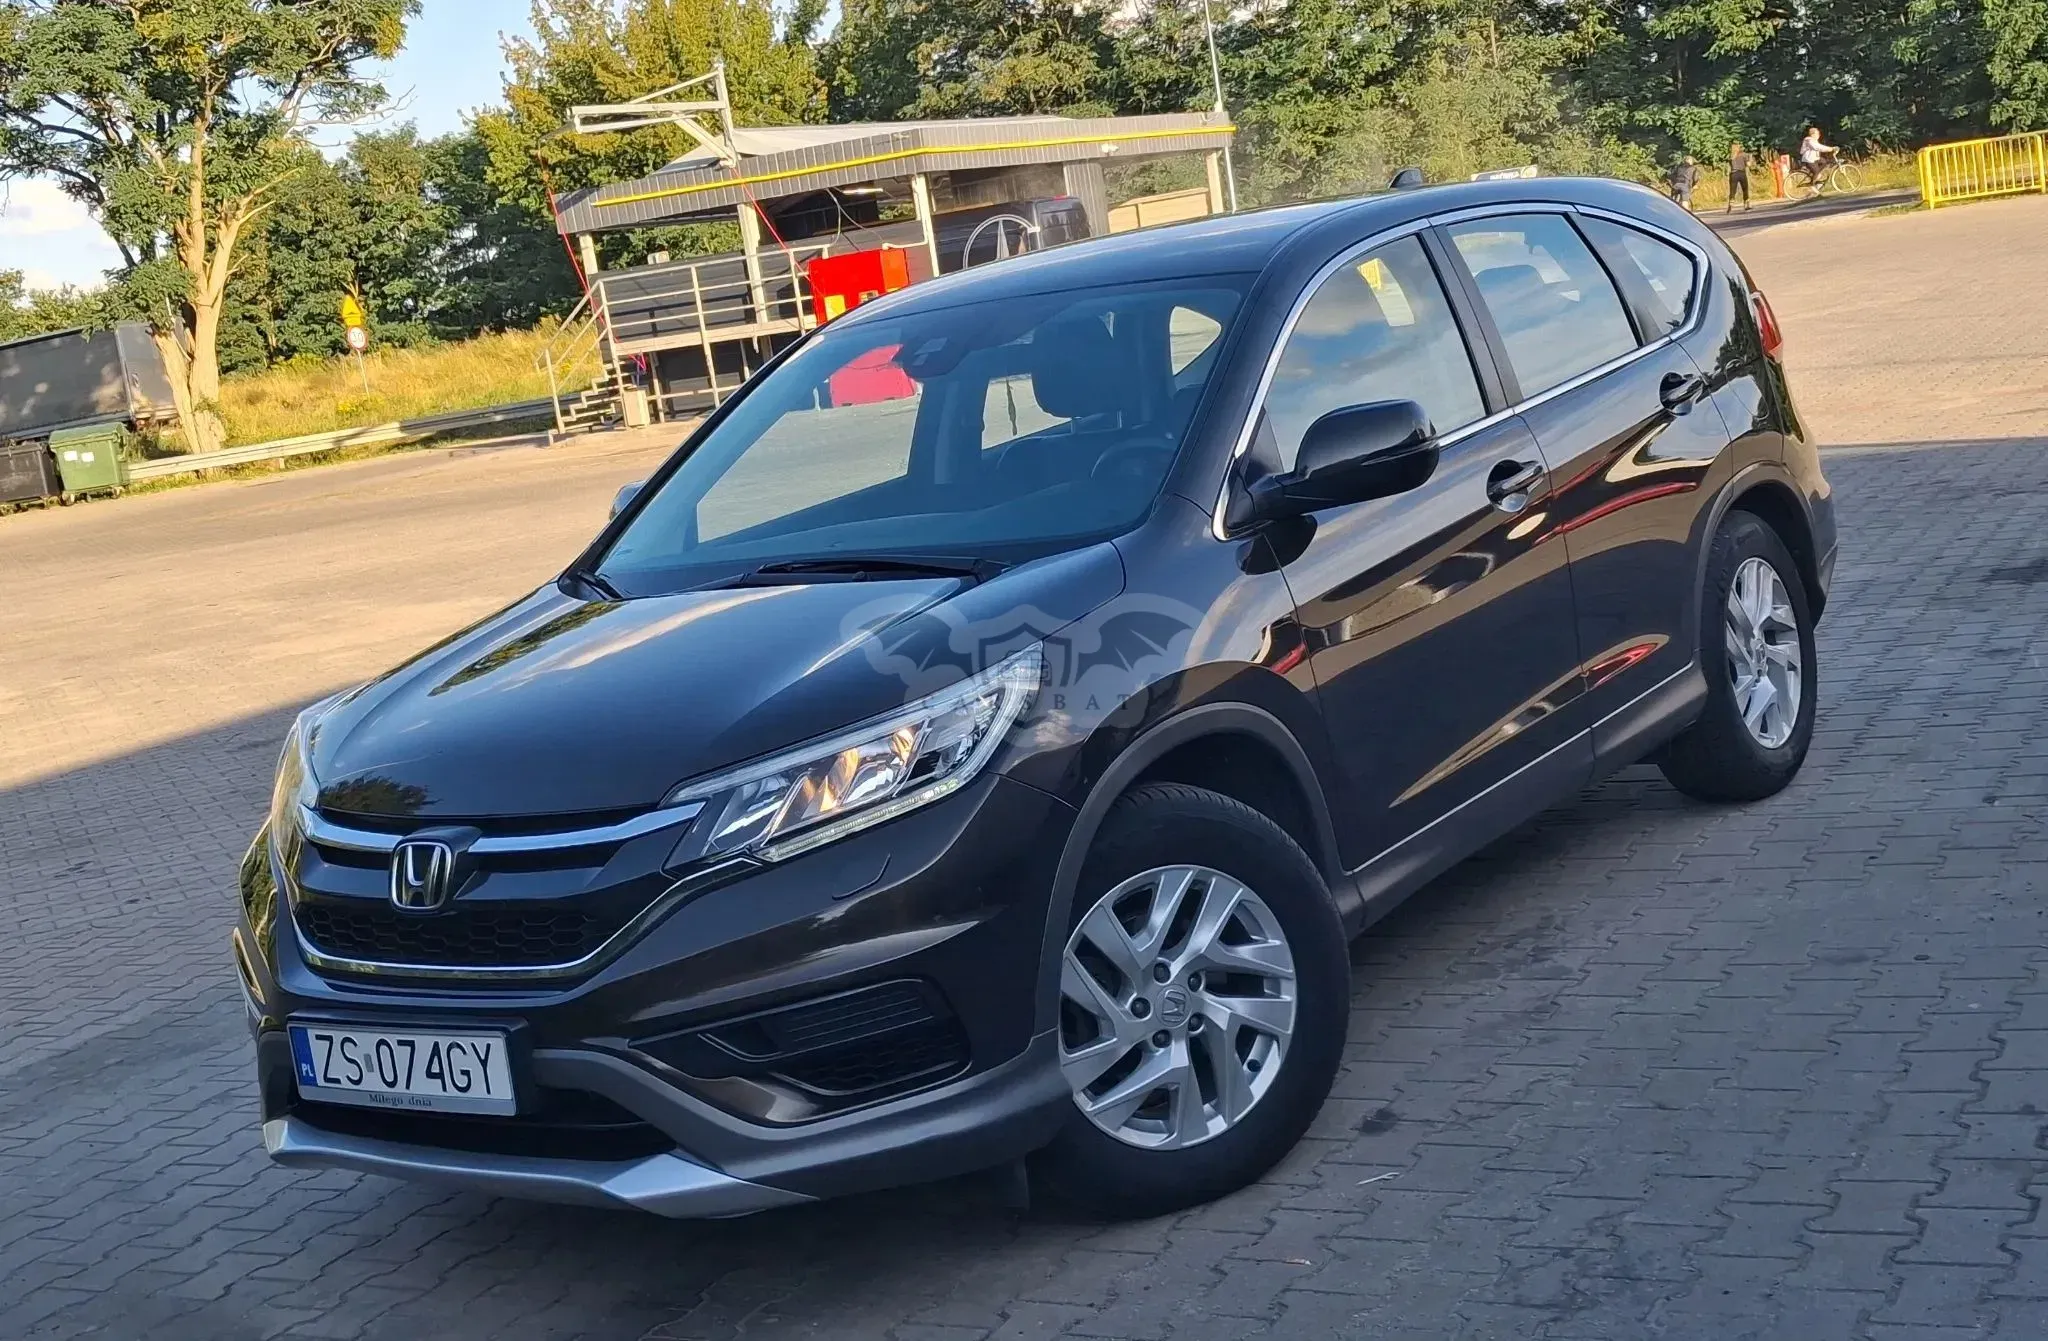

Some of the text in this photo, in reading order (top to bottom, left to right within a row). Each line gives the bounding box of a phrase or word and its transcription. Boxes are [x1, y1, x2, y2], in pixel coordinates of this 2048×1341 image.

[301, 1063, 314, 1077] PL
[315, 1034, 492, 1095] ZS 074GY
[408, 1096, 432, 1107] dnia
